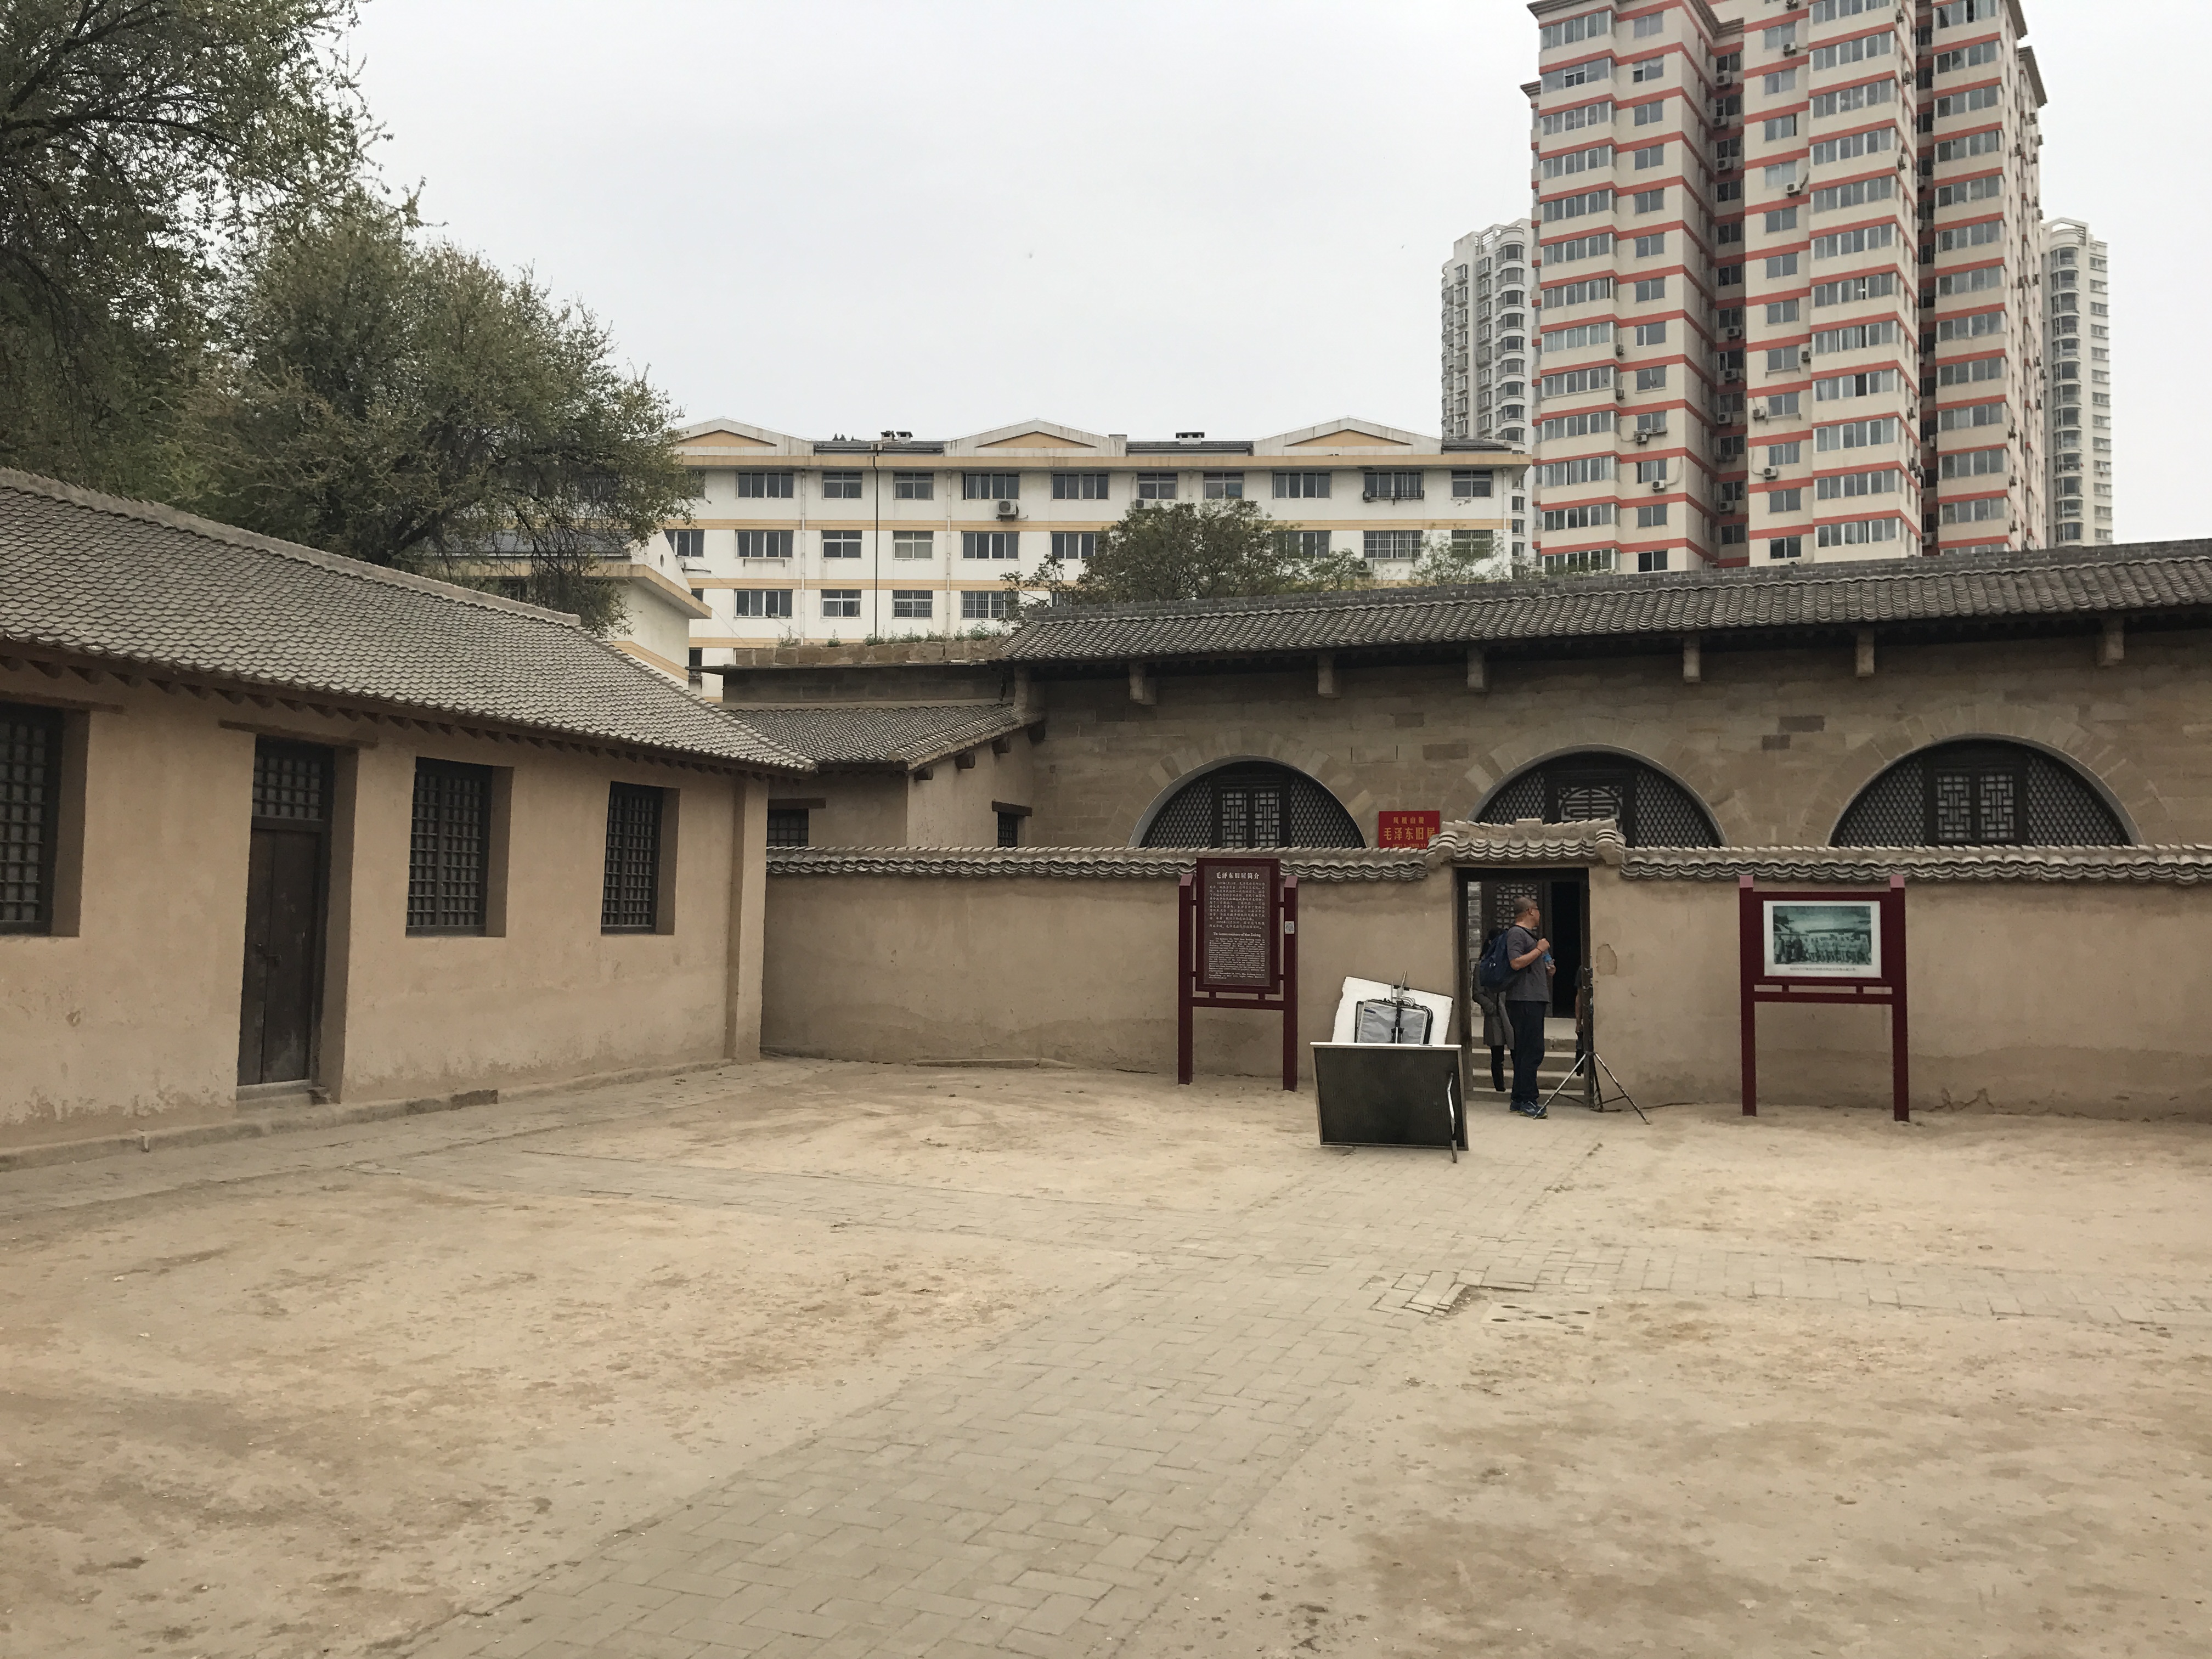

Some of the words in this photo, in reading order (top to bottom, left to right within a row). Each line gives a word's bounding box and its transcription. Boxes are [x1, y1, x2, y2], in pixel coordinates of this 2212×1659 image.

[1384, 827, 1436, 840] 毛泽东旧居
